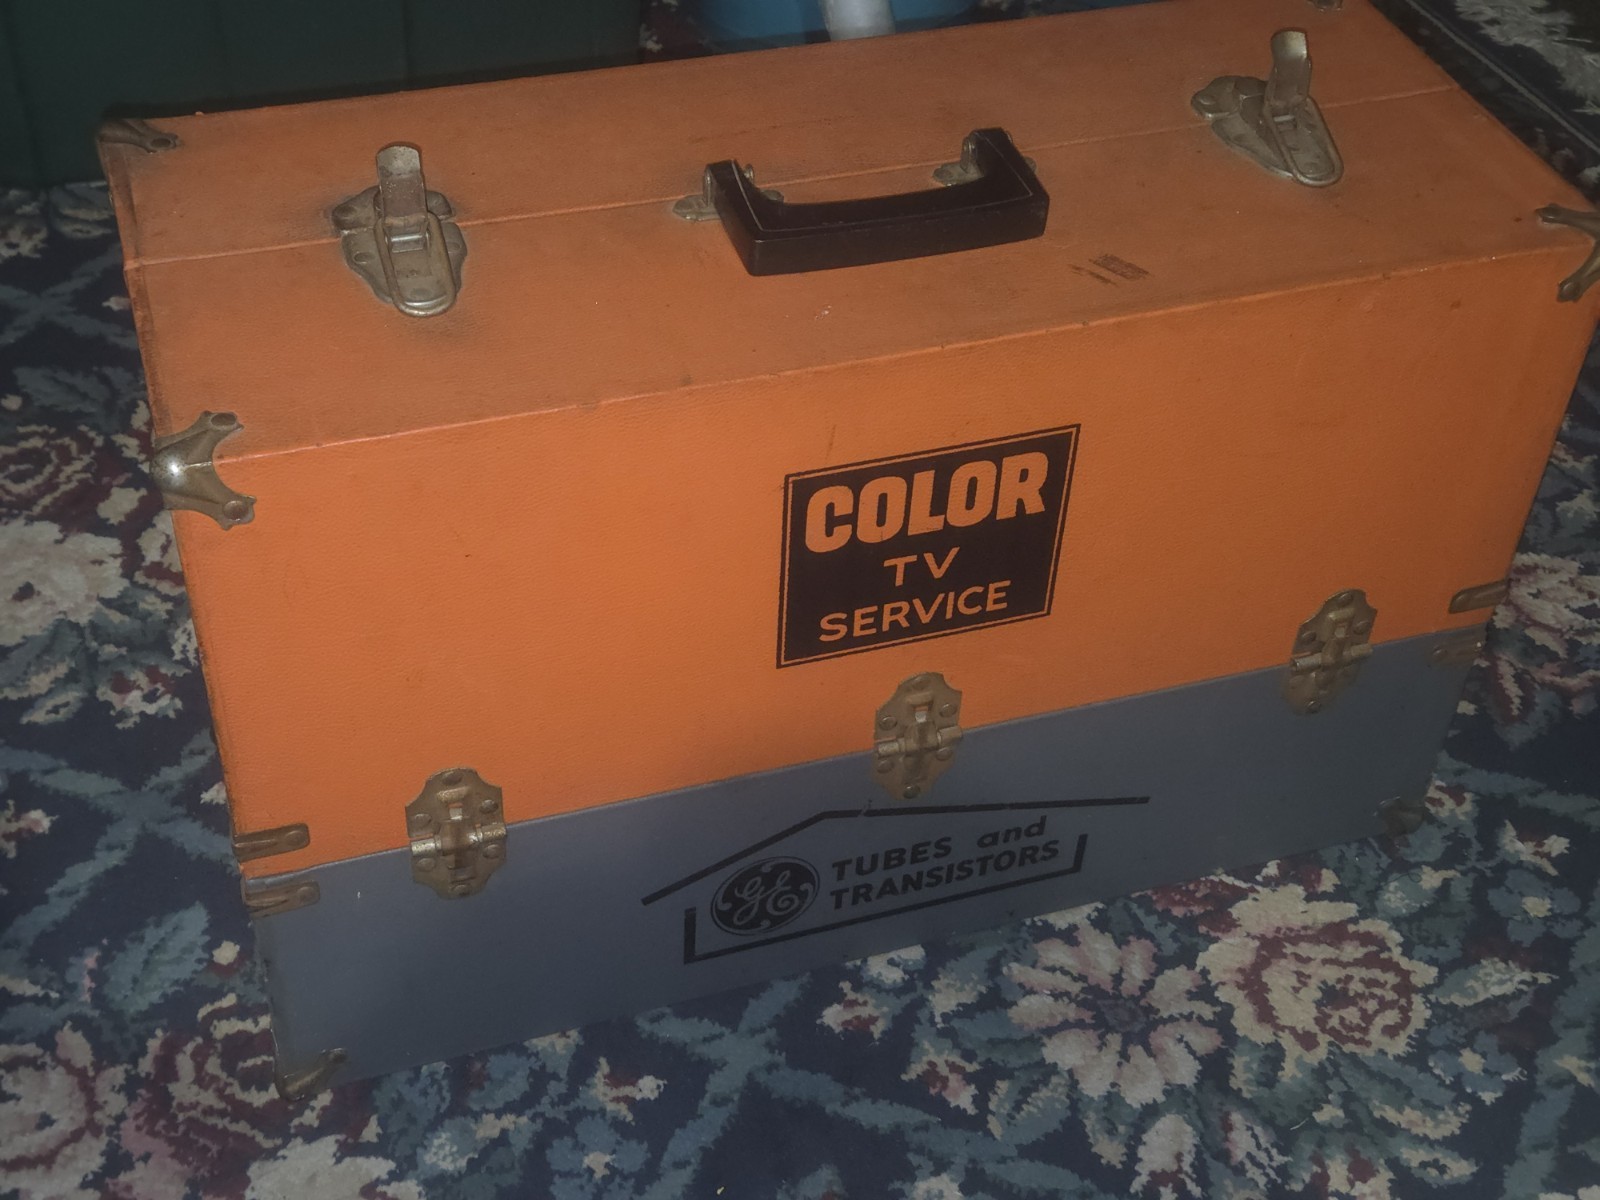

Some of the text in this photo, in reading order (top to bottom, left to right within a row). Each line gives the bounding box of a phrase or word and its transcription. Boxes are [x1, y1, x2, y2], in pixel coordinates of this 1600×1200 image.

[804, 451, 1049, 553] COLOR
[883, 546, 960, 587] TV
[818, 580, 1011, 642] SERVICE
[830, 839, 1060, 911] TRANSISTORS
[832, 815, 1047, 883] TUBES and
